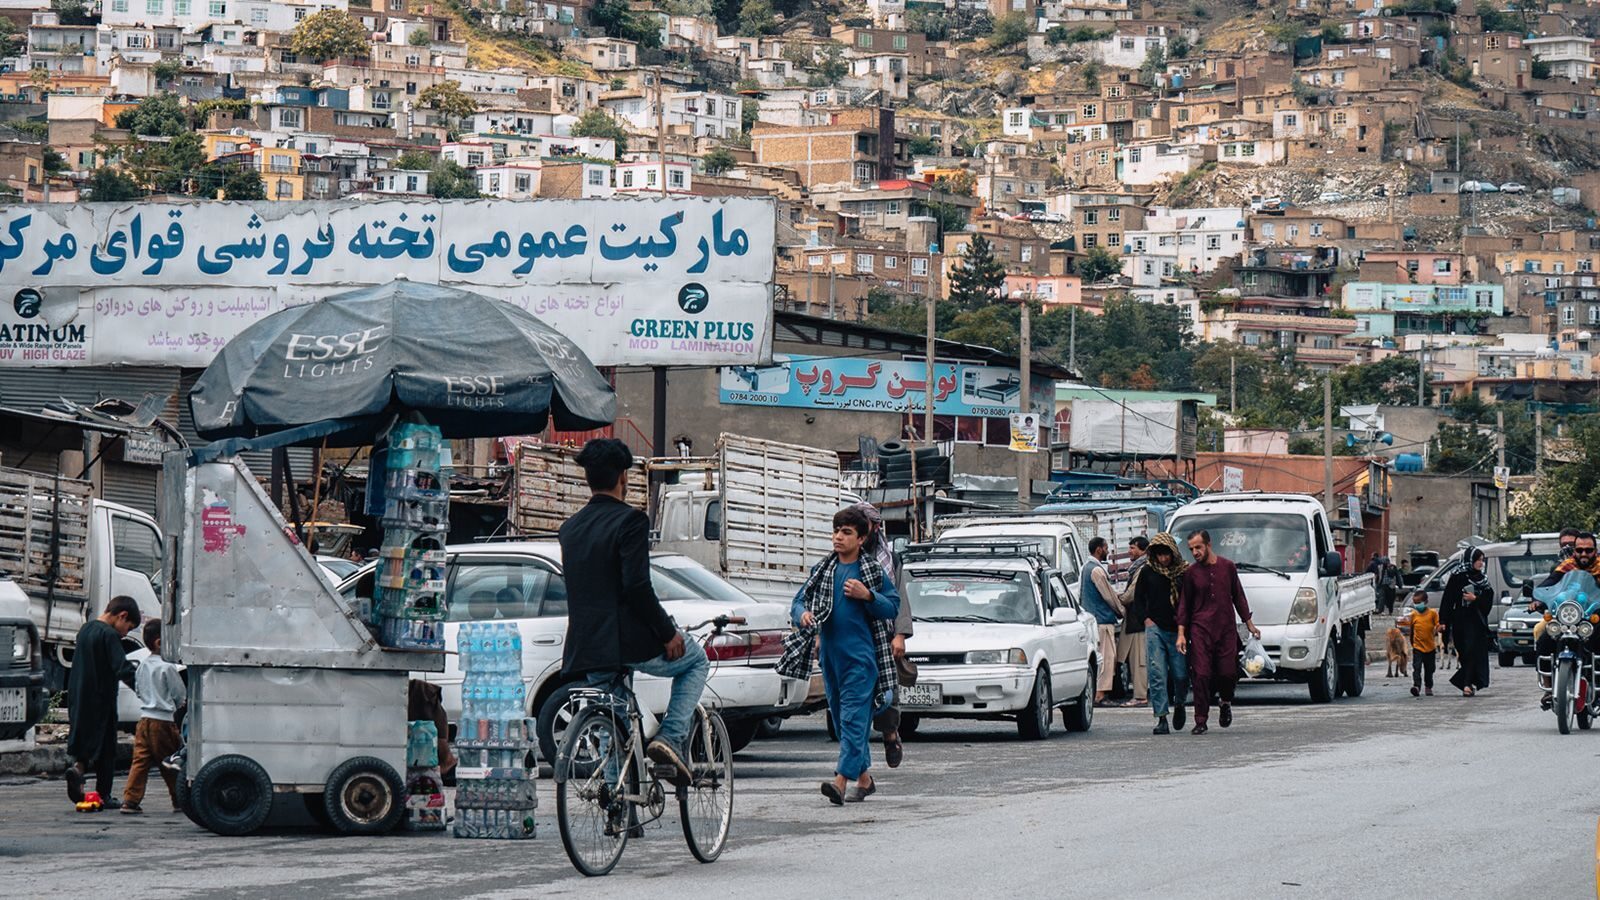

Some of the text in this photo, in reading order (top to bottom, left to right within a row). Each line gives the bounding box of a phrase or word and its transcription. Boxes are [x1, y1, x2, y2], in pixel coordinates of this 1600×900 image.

[0, 214, 77, 276] مرک
[90, 210, 185, 275] قوای
[347, 212, 436, 259] تخته
[447, 224, 588, 274] عمومی
[630, 318, 754, 341] GREEN PLUS
[23, 349, 49, 360] HIGH
[52, 349, 86, 360] GLAZE
[285, 324, 385, 361] ESSE
[629, 338, 754, 354] MOD LAMINATION
[283, 355, 374, 379] LIGHTS
[444, 375, 505, 396] ESSE
[886, 365, 958, 401] نون
[447, 395, 505, 408] LIGHTS
[729, 393, 779, 403] 0784 2000 10
